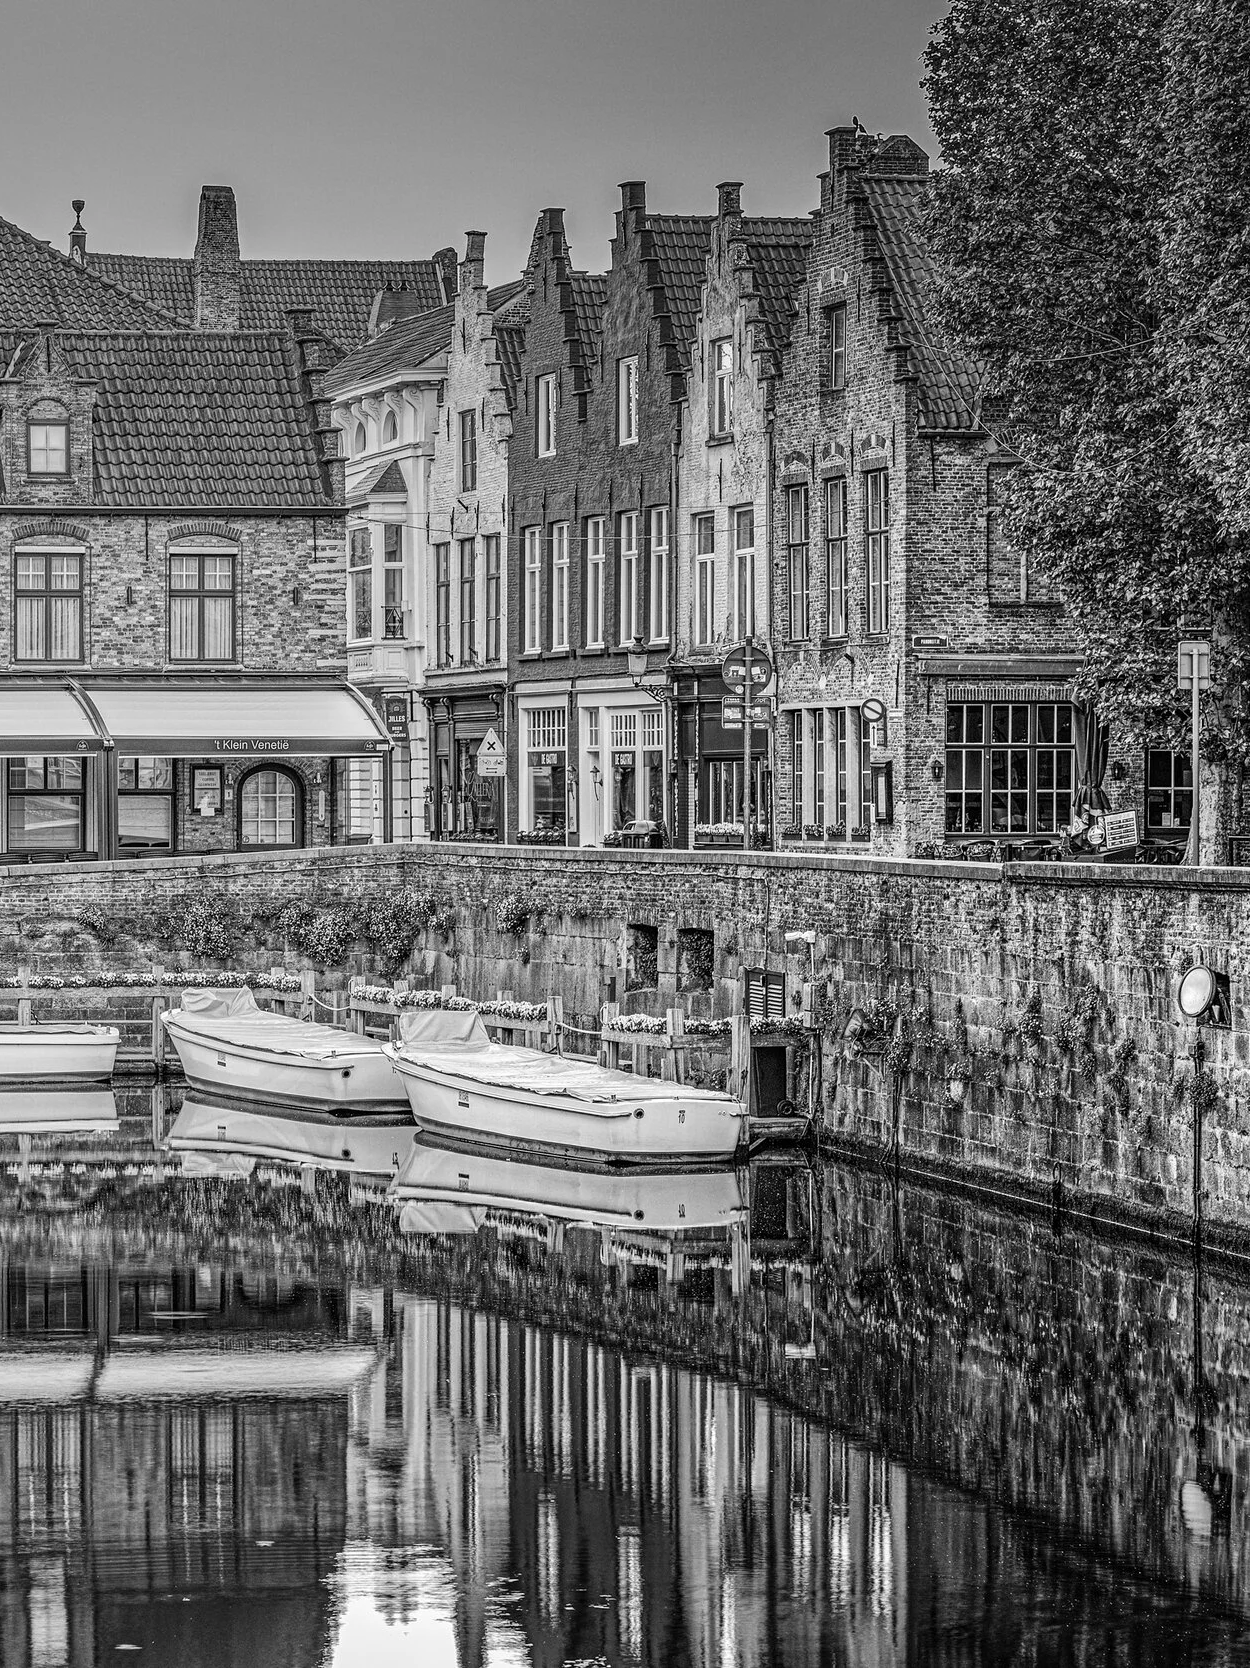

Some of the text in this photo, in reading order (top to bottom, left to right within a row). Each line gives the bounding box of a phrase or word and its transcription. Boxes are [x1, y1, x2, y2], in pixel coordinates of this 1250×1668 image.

[214, 739, 289, 750] 't Klein Venetië
